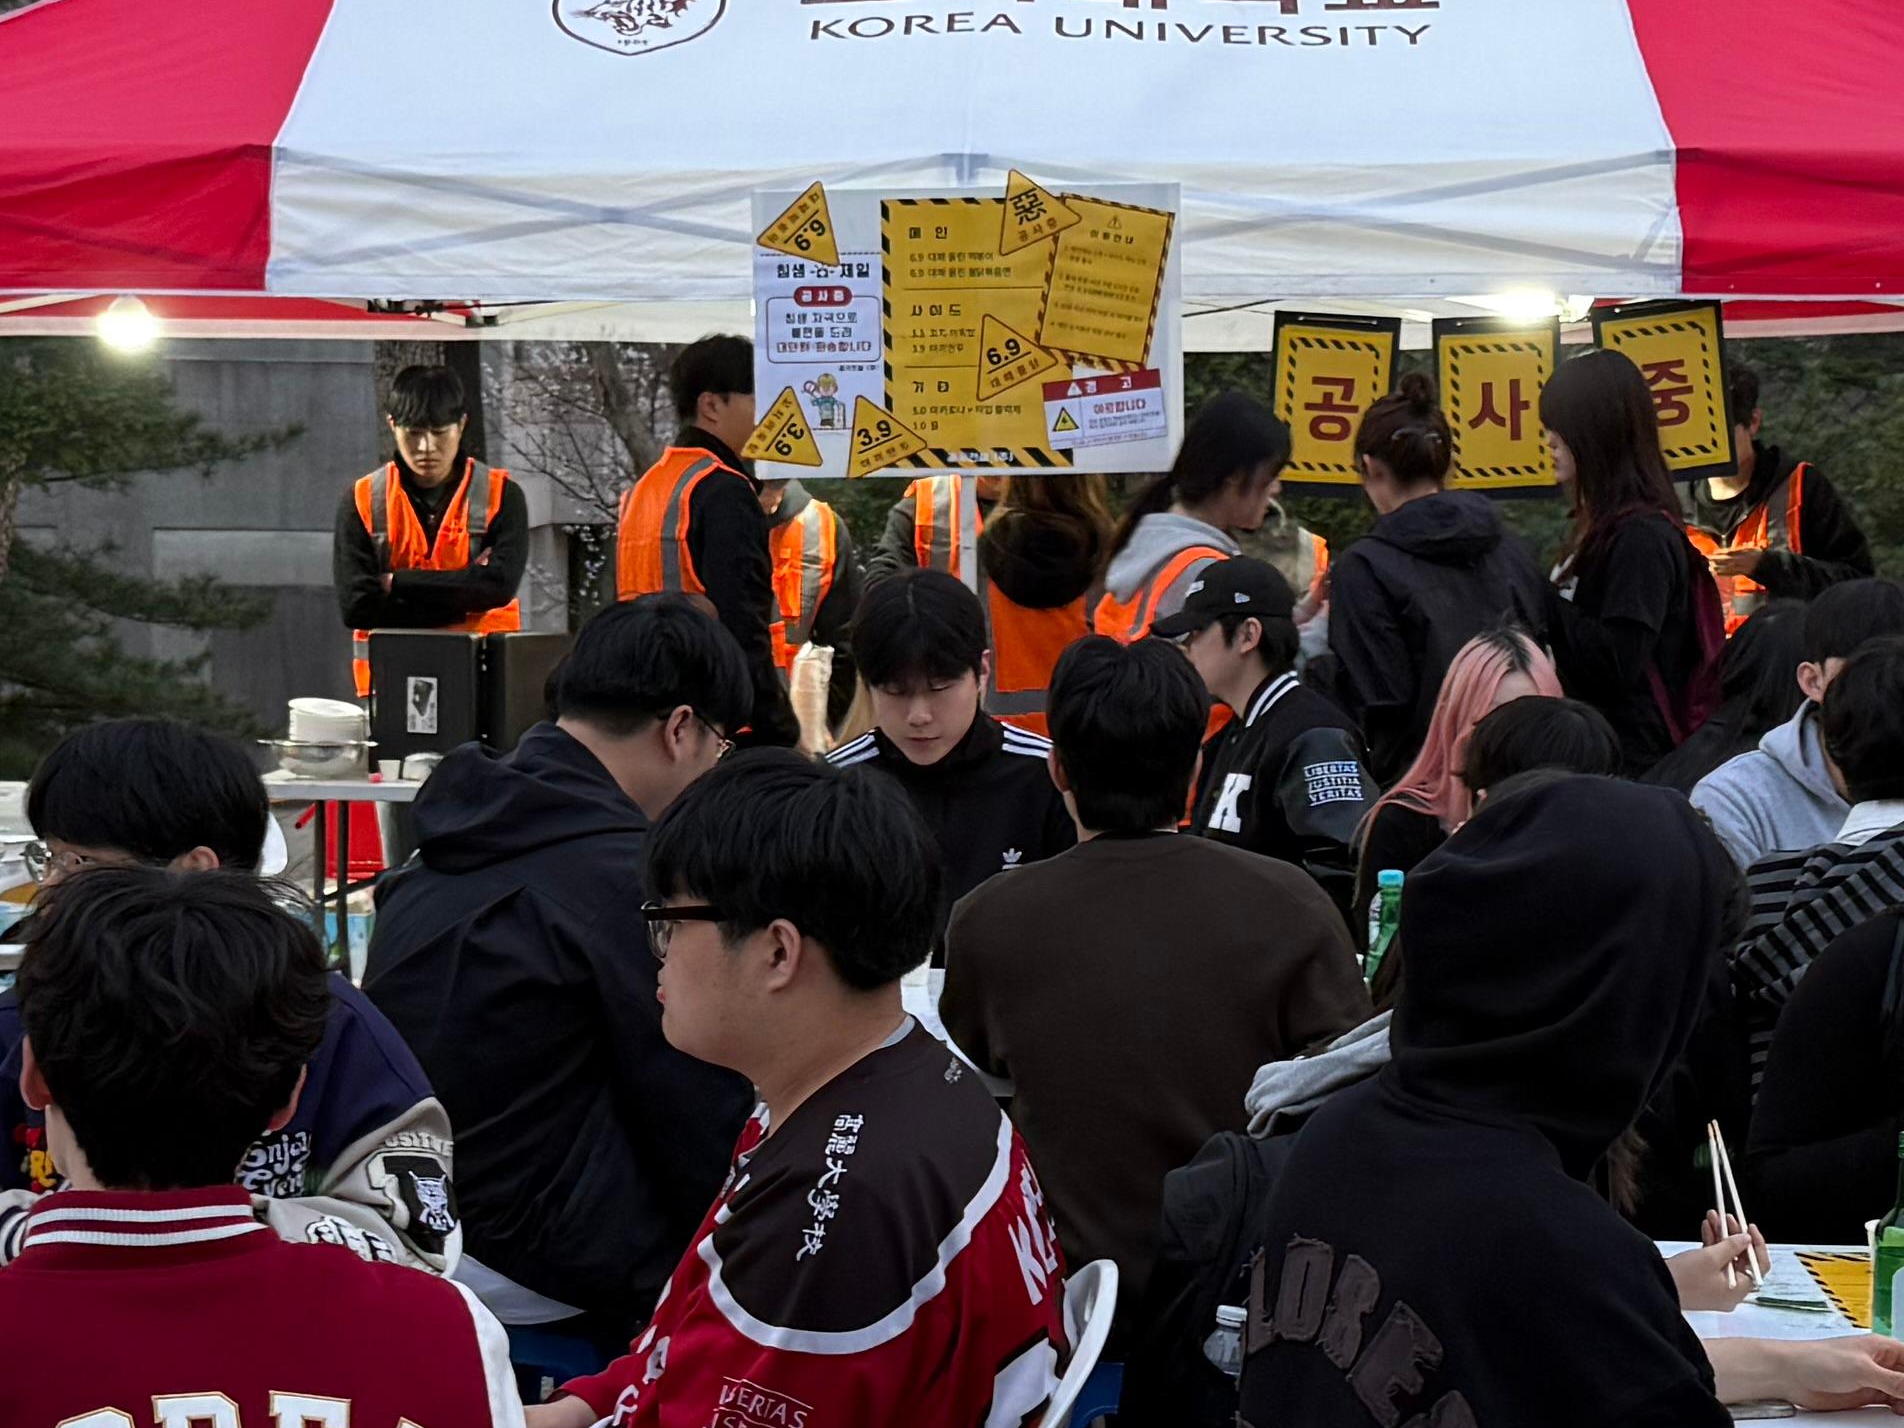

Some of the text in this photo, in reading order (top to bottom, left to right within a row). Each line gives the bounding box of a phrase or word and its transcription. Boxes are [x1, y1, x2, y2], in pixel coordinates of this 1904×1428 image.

[810, 11, 1431, 46] KOREA UNIVERSITY
[795, 218, 826, 251] 6.9
[986, 338, 1021, 366] 6.9
[1304, 359, 1695, 442] 공 사 중
[774, 422, 805, 456] 3.9
[857, 419, 892, 447] 3.9
[1304, 762, 1358, 778] LIBERTAS
[1207, 772, 1253, 833] K
[1308, 789, 1363, 803] VERITAS
